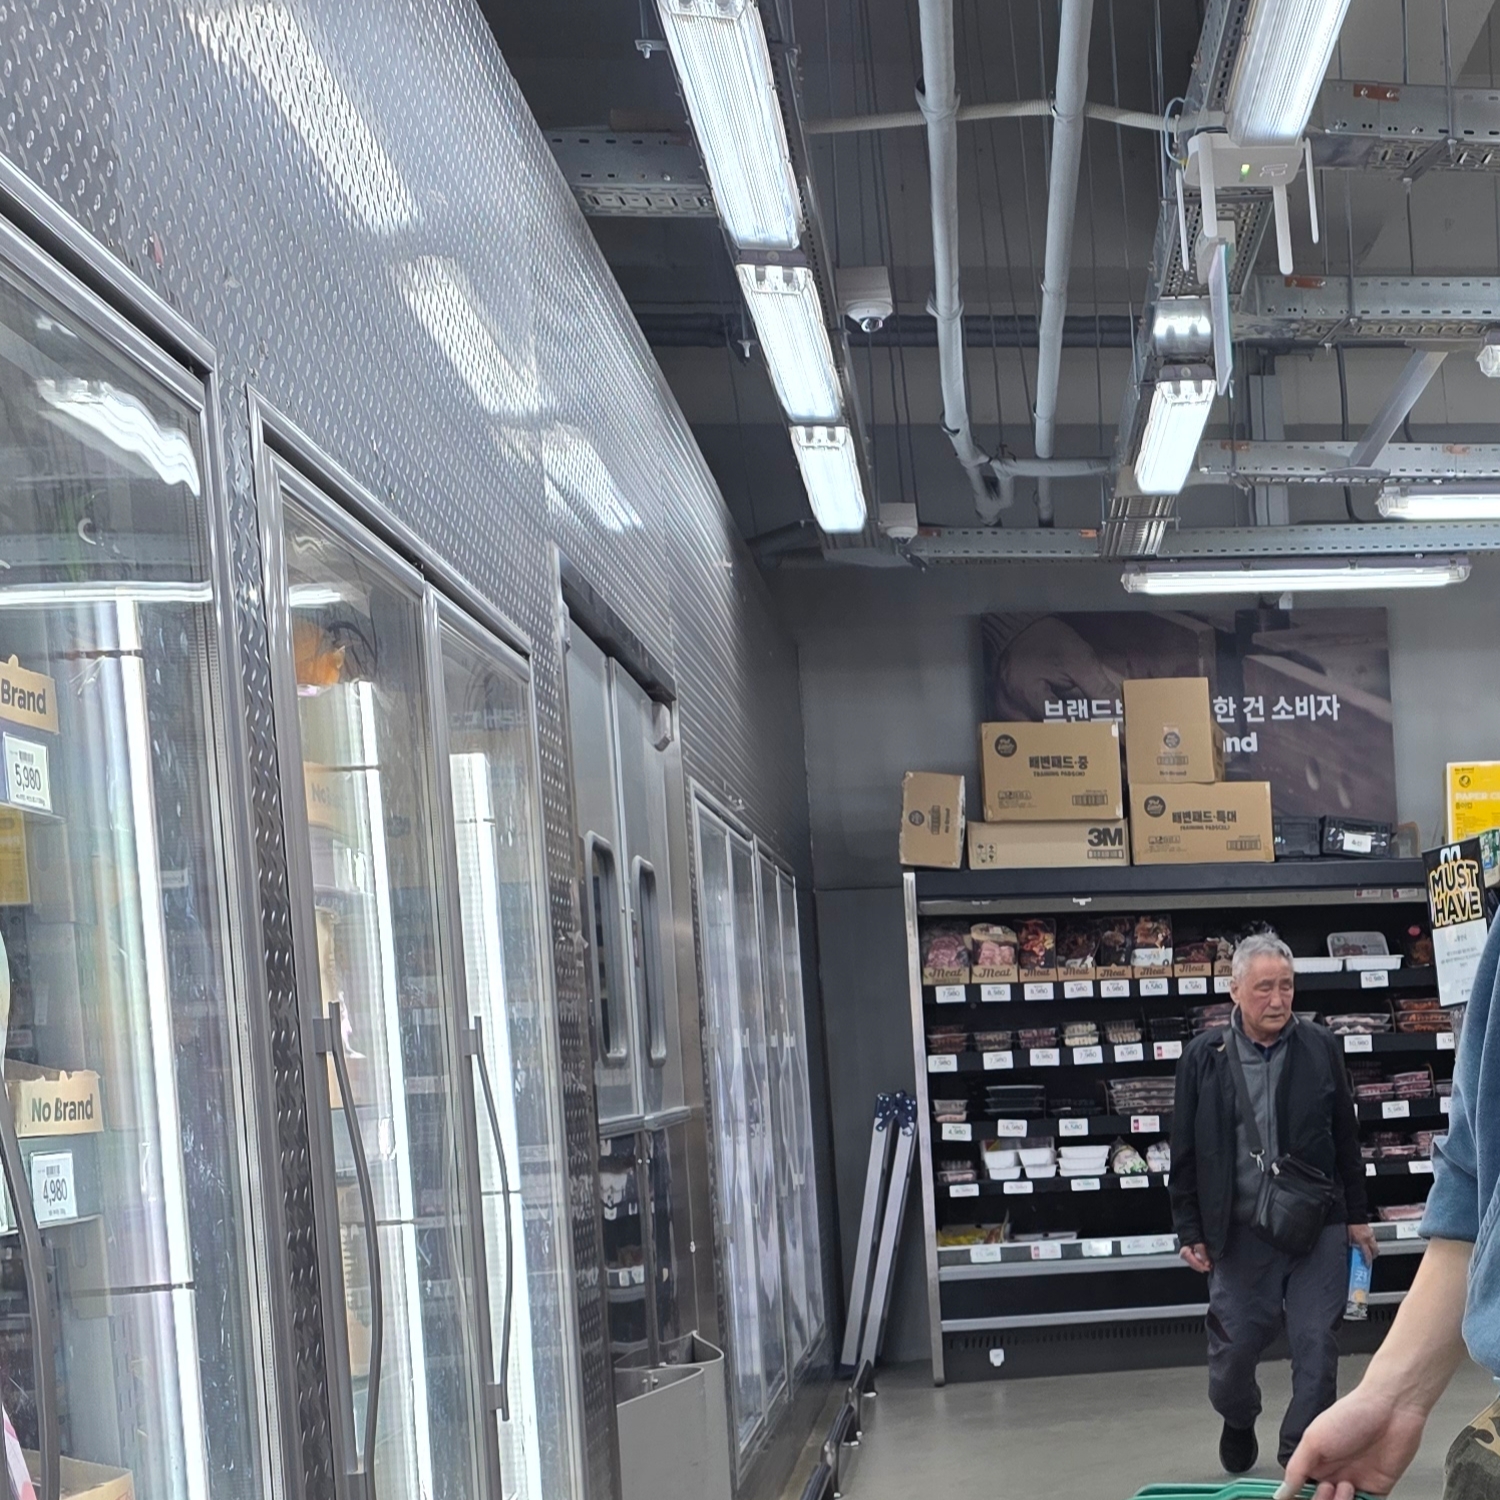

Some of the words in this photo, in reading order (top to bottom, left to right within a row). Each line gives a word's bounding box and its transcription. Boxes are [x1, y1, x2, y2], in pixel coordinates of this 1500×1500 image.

[0, 678, 48, 716] Brand
[1242, 696, 1266, 721] 건
[1271, 694, 1341, 721] 소비자
[15, 762, 42, 792] 5,980
[1087, 827, 1123, 847] 3M
[1430, 860, 1479, 896] MUST
[1433, 889, 1482, 928] HAVE
[928, 968, 963, 977] Meat
[979, 968, 1013, 977] Meat
[31, 1097, 52, 1123] No
[54, 1093, 94, 1123] Brand
[43, 1177, 68, 1206] 4,980
